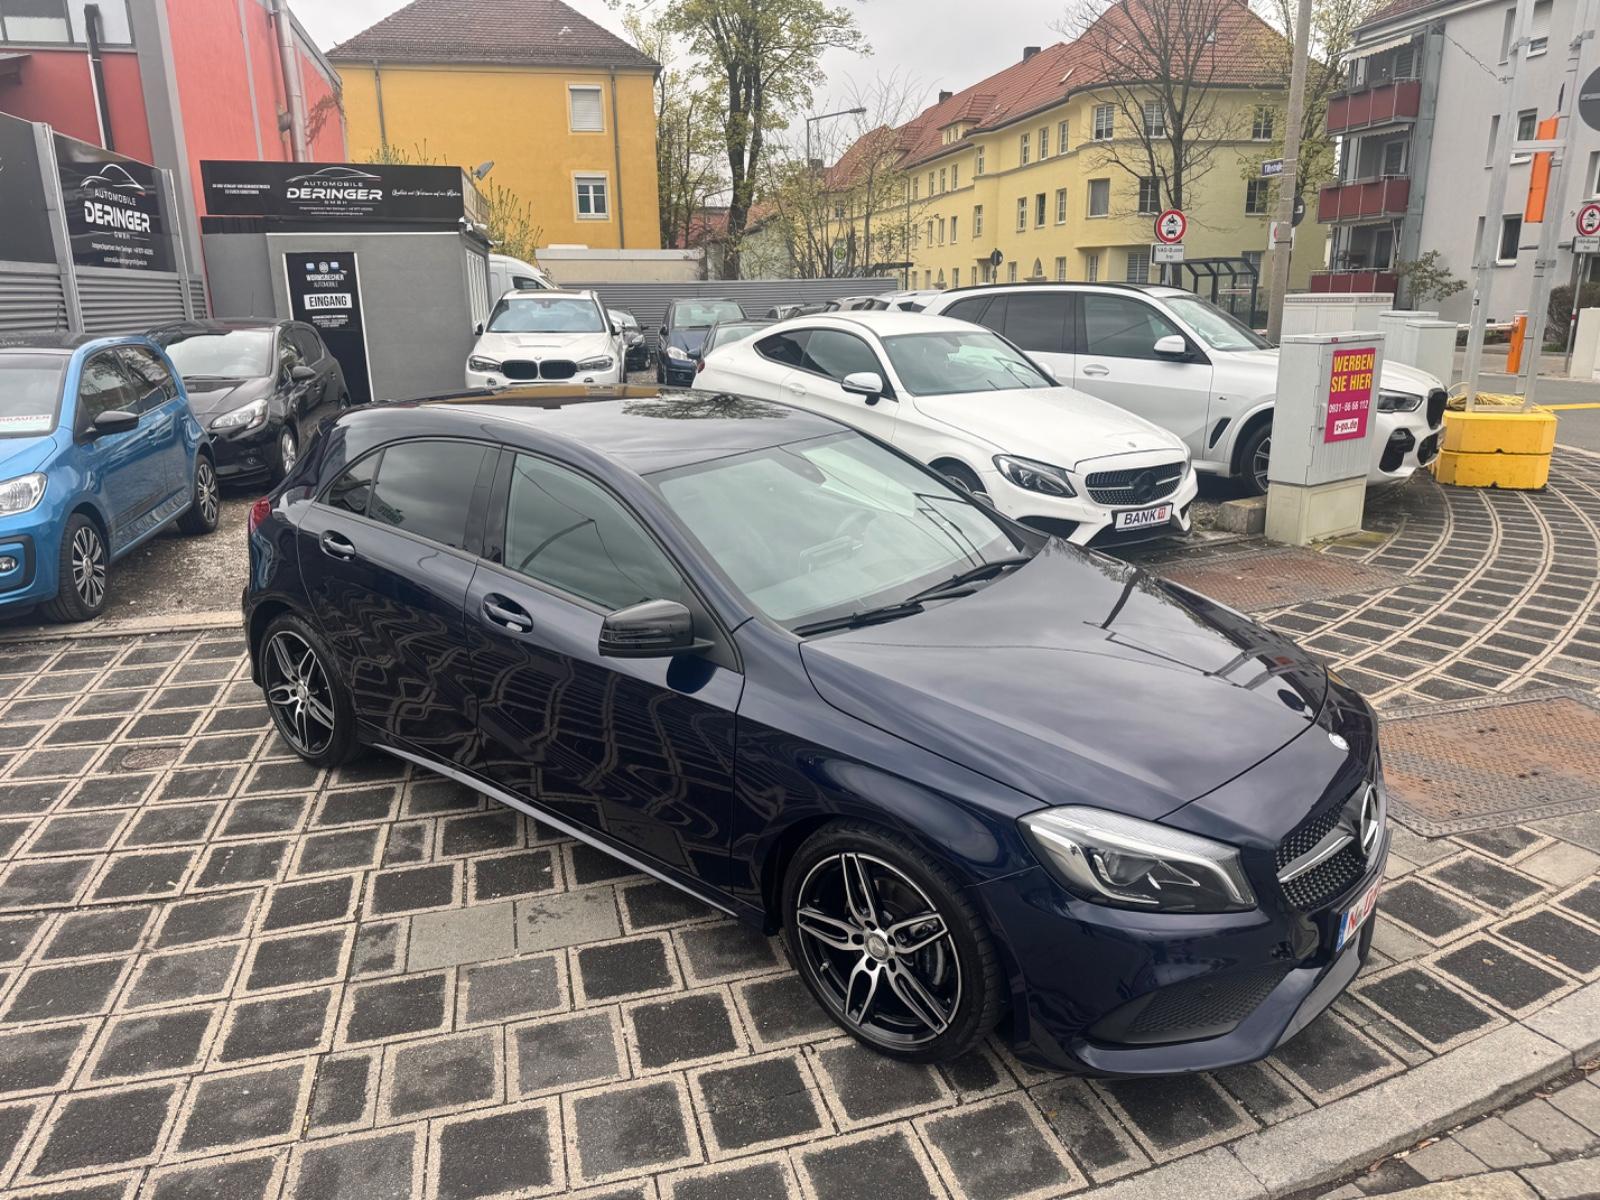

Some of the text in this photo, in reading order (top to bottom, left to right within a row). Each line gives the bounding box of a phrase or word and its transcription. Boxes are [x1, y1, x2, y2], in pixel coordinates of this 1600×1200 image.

[95, 188, 136, 206] AUTOMOBILE
[286, 187, 383, 200] DERINGER
[84, 200, 151, 233] DERINGER
[309, 295, 347, 307] EINGANG
[1334, 354, 1374, 372] WERBEN
[1331, 373, 1372, 392] SIE HIER
